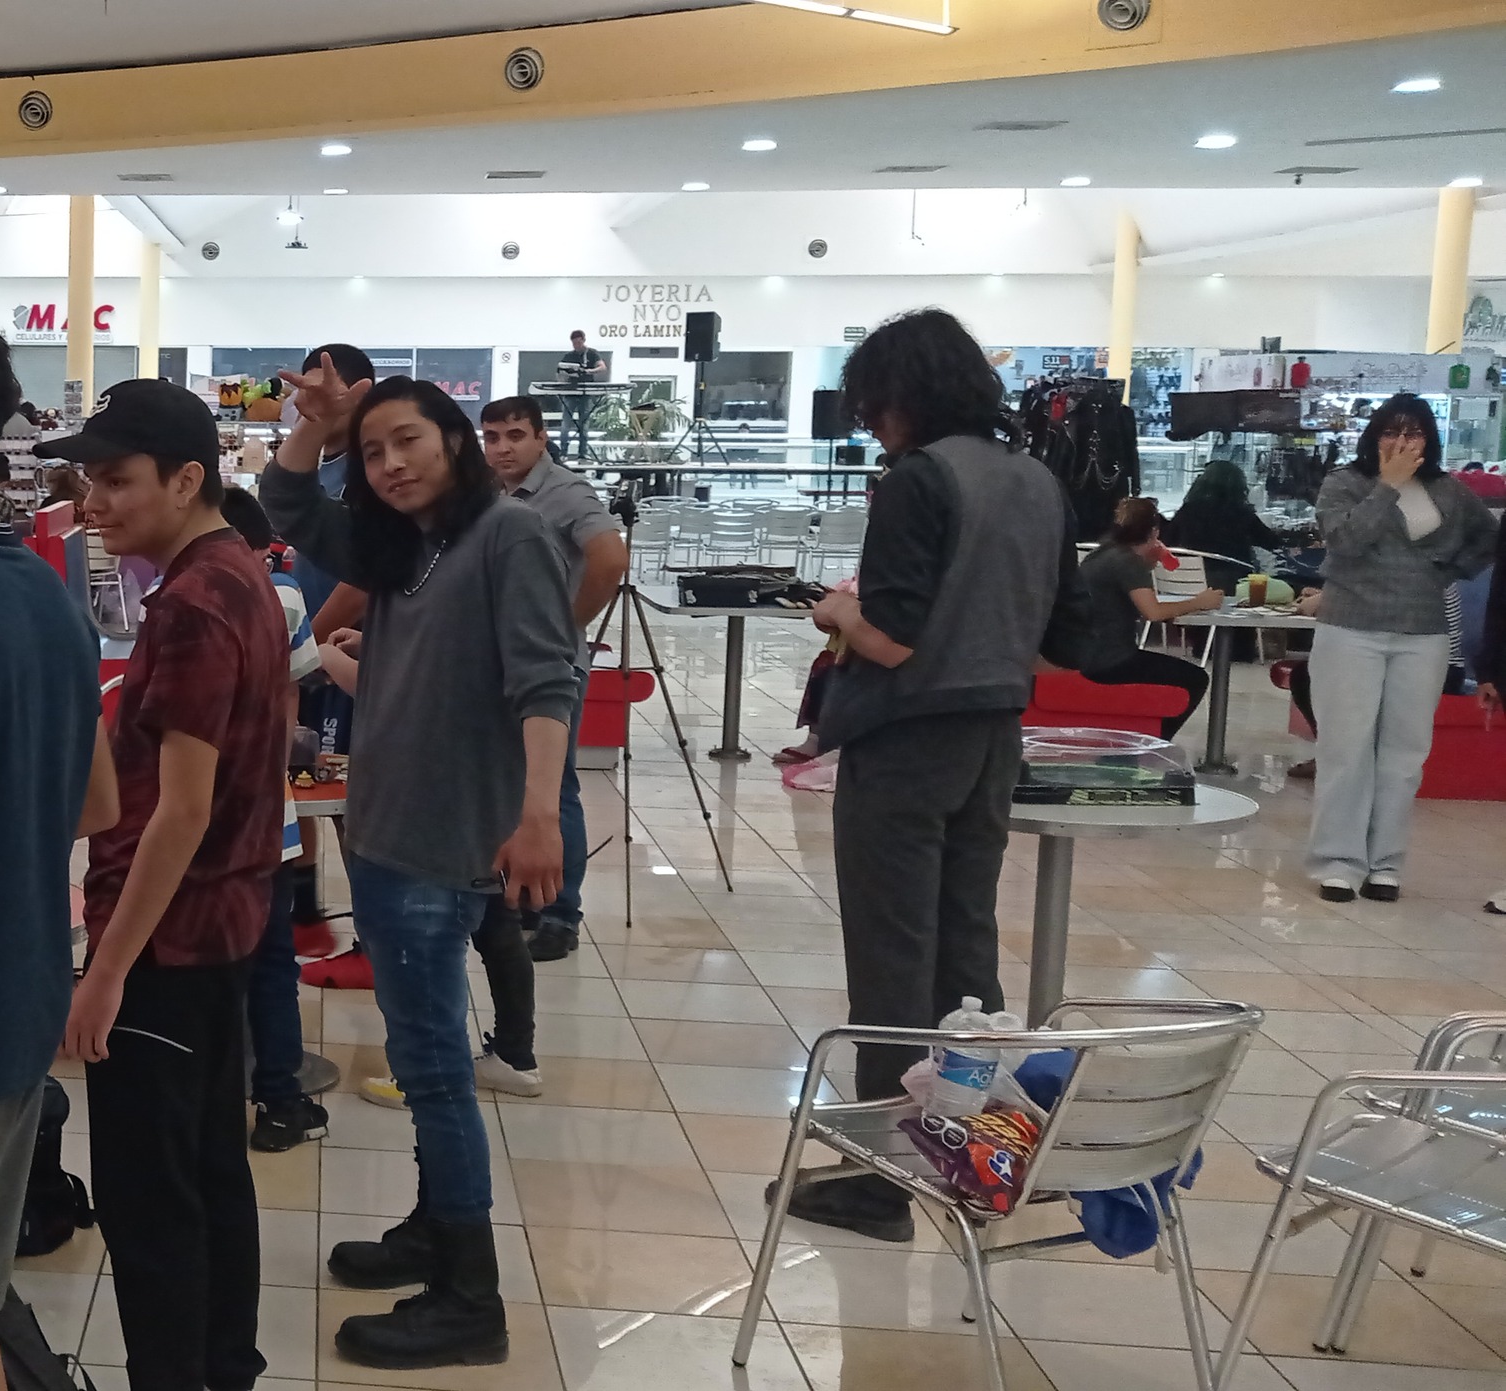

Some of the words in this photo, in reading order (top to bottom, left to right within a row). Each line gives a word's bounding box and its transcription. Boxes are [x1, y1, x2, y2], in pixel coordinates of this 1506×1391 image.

[602, 284, 714, 303] JOYERIA
[26, 304, 115, 331] MC
[632, 304, 682, 322] NYO
[15, 333, 56, 341] CELULARES
[598, 325, 628, 338] ORO
[633, 325, 687, 338] LAMIN
